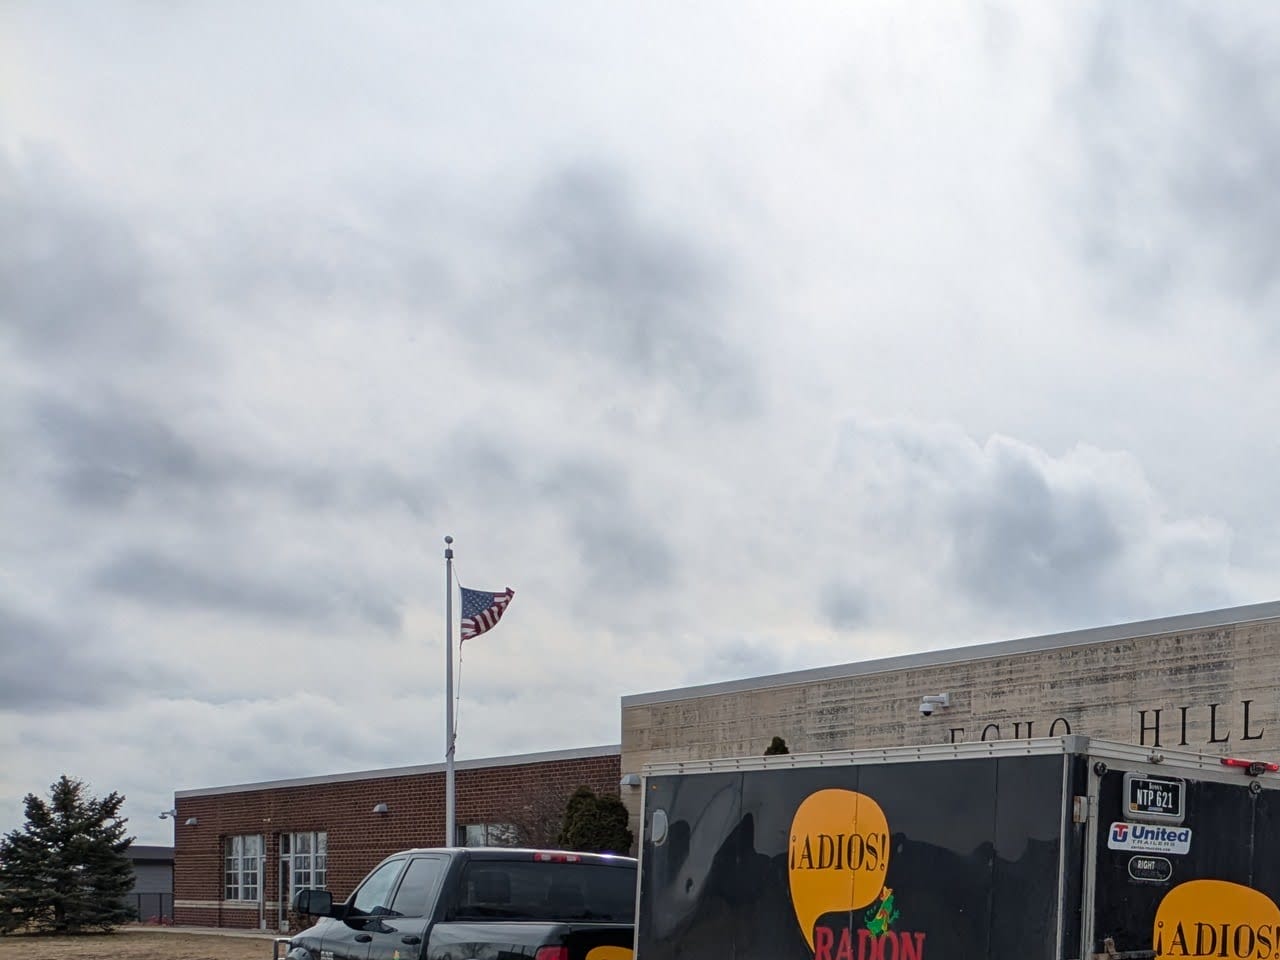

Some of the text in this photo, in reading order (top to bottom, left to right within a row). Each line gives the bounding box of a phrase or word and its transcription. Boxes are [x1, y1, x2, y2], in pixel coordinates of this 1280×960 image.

[1138, 699, 1265, 749] HILL
[1137, 788, 1173, 808] NTP 621
[1132, 826, 1189, 842] United
[789, 833, 891, 872] ¡ADIOS!
[1137, 860, 1155, 870] RIGHT
